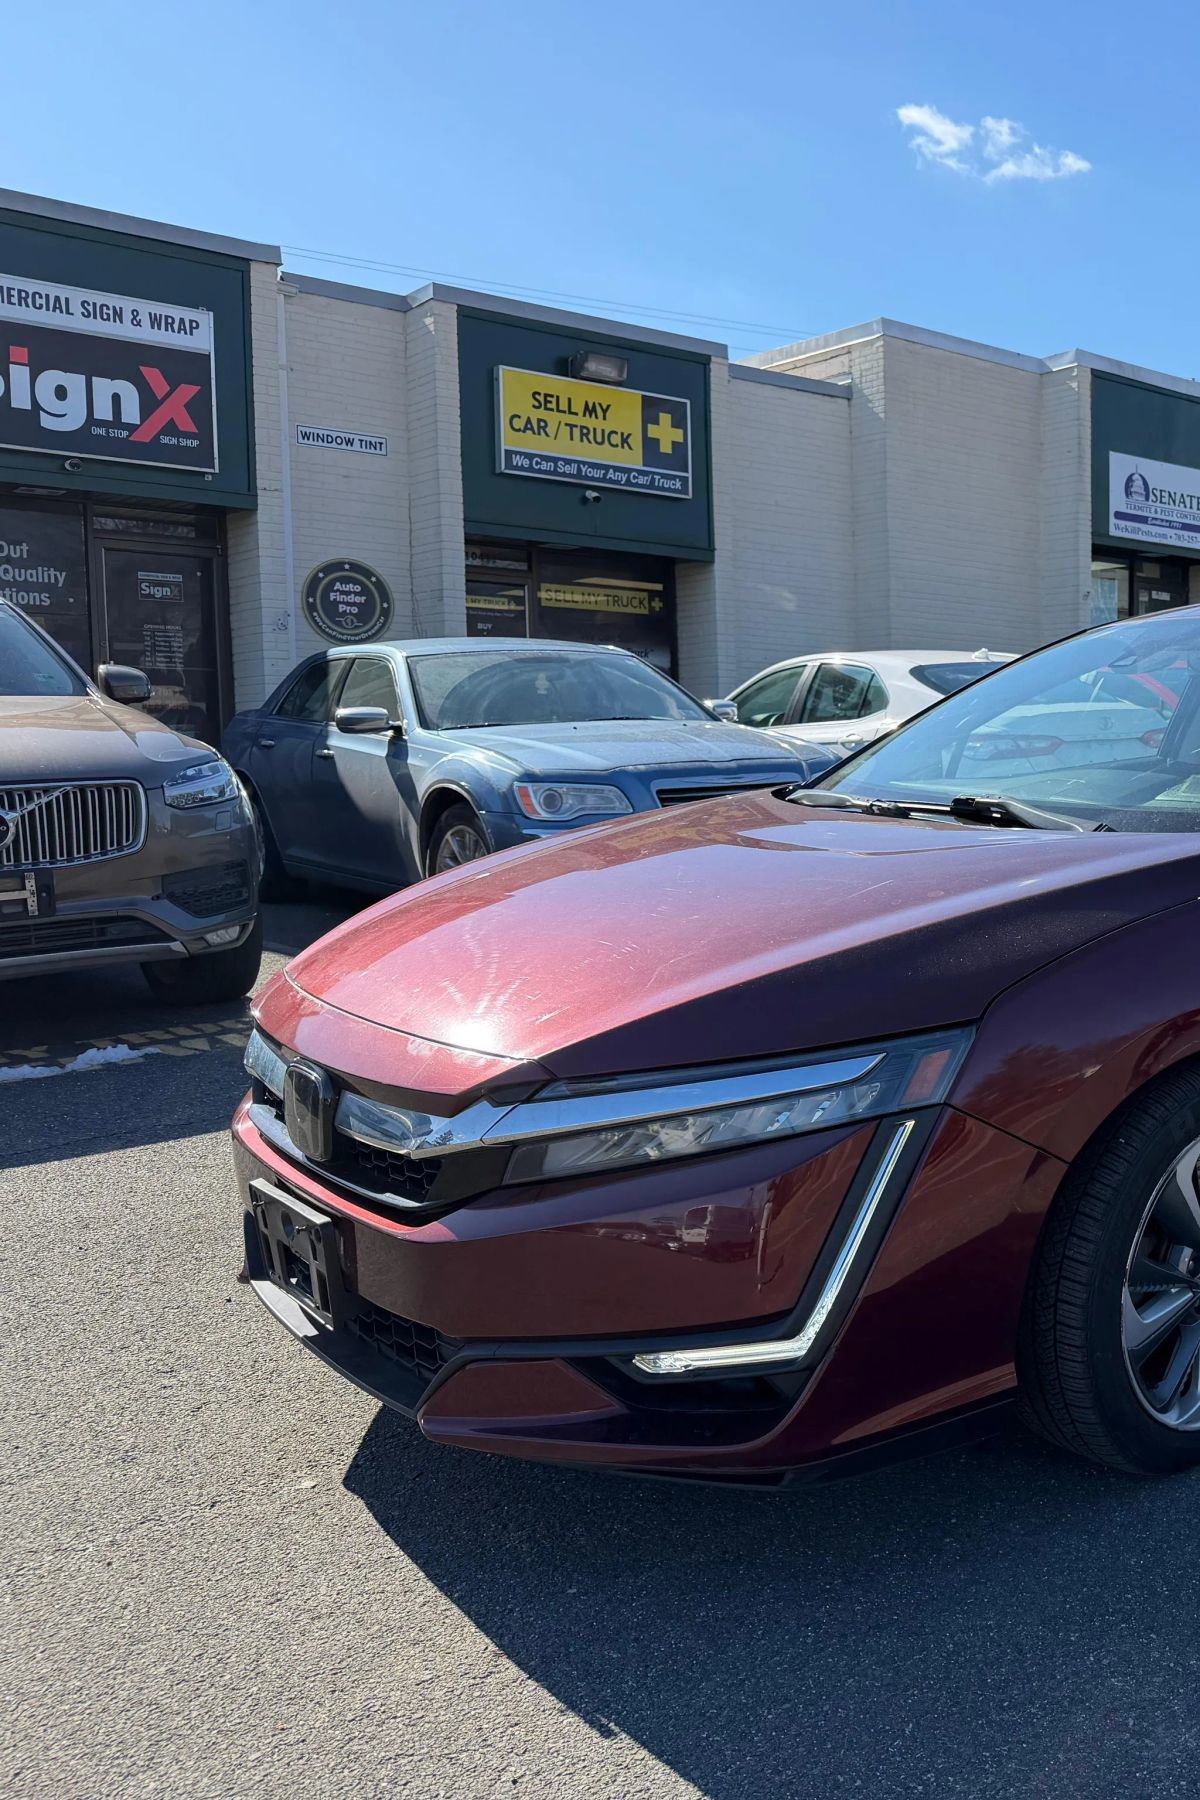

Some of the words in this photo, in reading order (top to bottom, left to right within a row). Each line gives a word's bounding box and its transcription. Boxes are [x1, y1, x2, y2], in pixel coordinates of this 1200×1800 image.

[80, 300, 124, 325] SIGN
[130, 308, 143, 328] &
[148, 311, 201, 337] WRAP
[531, 391, 578, 416] SELL
[582, 400, 612, 421] MY
[91, 426, 107, 437] ONE
[109, 428, 129, 439] STOP
[159, 435, 178, 446] SIGN
[179, 437, 200, 448] SHOP
[300, 430, 355, 448] WINDOW
[358, 439, 384, 452] TINT
[509, 414, 550, 438] CAR
[564, 423, 634, 450] TRUCK
[511, 454, 530, 467] We
[532, 457, 554, 471] Can
[557, 461, 578, 475] Sell
[580, 465, 604, 478] Your
[606, 469, 628, 485] Any
[653, 475, 683, 490] Truck
[1125, 502, 1152, 514] TERMITE
[1160, 508, 1174, 518] PEST
[0, 564, 66, 588] Quality
[0, 588, 51, 606] tions
[333, 582, 361, 592] Auto
[329, 592, 367, 604] Finder
[544, 588, 580, 605] SELL
[581, 592, 602, 606] MY
[605, 593, 648, 611] TRUCK
[339, 604, 358, 614] Pro
